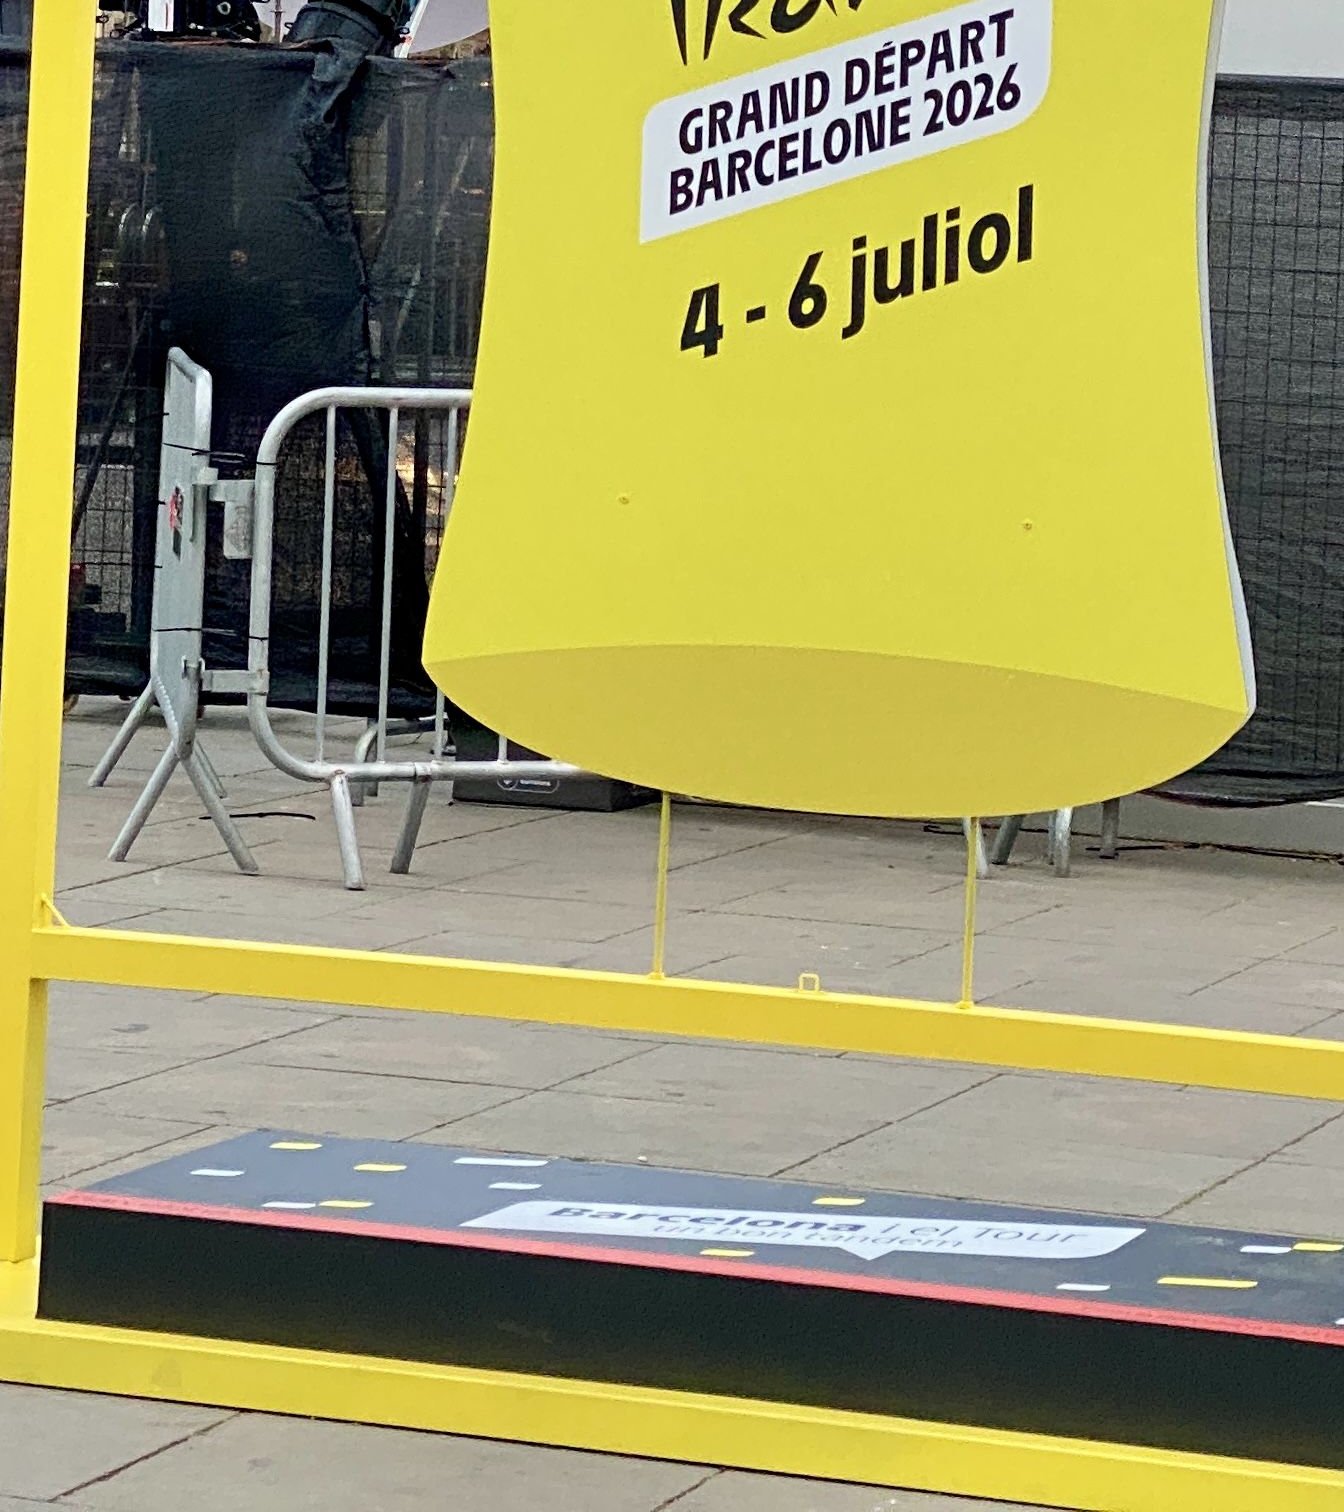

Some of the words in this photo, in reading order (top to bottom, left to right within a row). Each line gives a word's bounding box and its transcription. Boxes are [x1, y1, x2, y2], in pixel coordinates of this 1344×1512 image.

[668, 97, 912, 216] BARCELONE
[922, 62, 1022, 135] 2026
[678, 70, 830, 155] GRAND
[843, 8, 1015, 99] DÉPART
[679, 281, 724, 359] 4
[787, 250, 828, 330] 6
[841, 183, 1034, 340] juliol
[549, 1206, 866, 1232] Barcelona
[910, 1225, 959, 1237] el
[974, 1226, 1088, 1243] Tour
[804, 1232, 964, 1248] tandem
